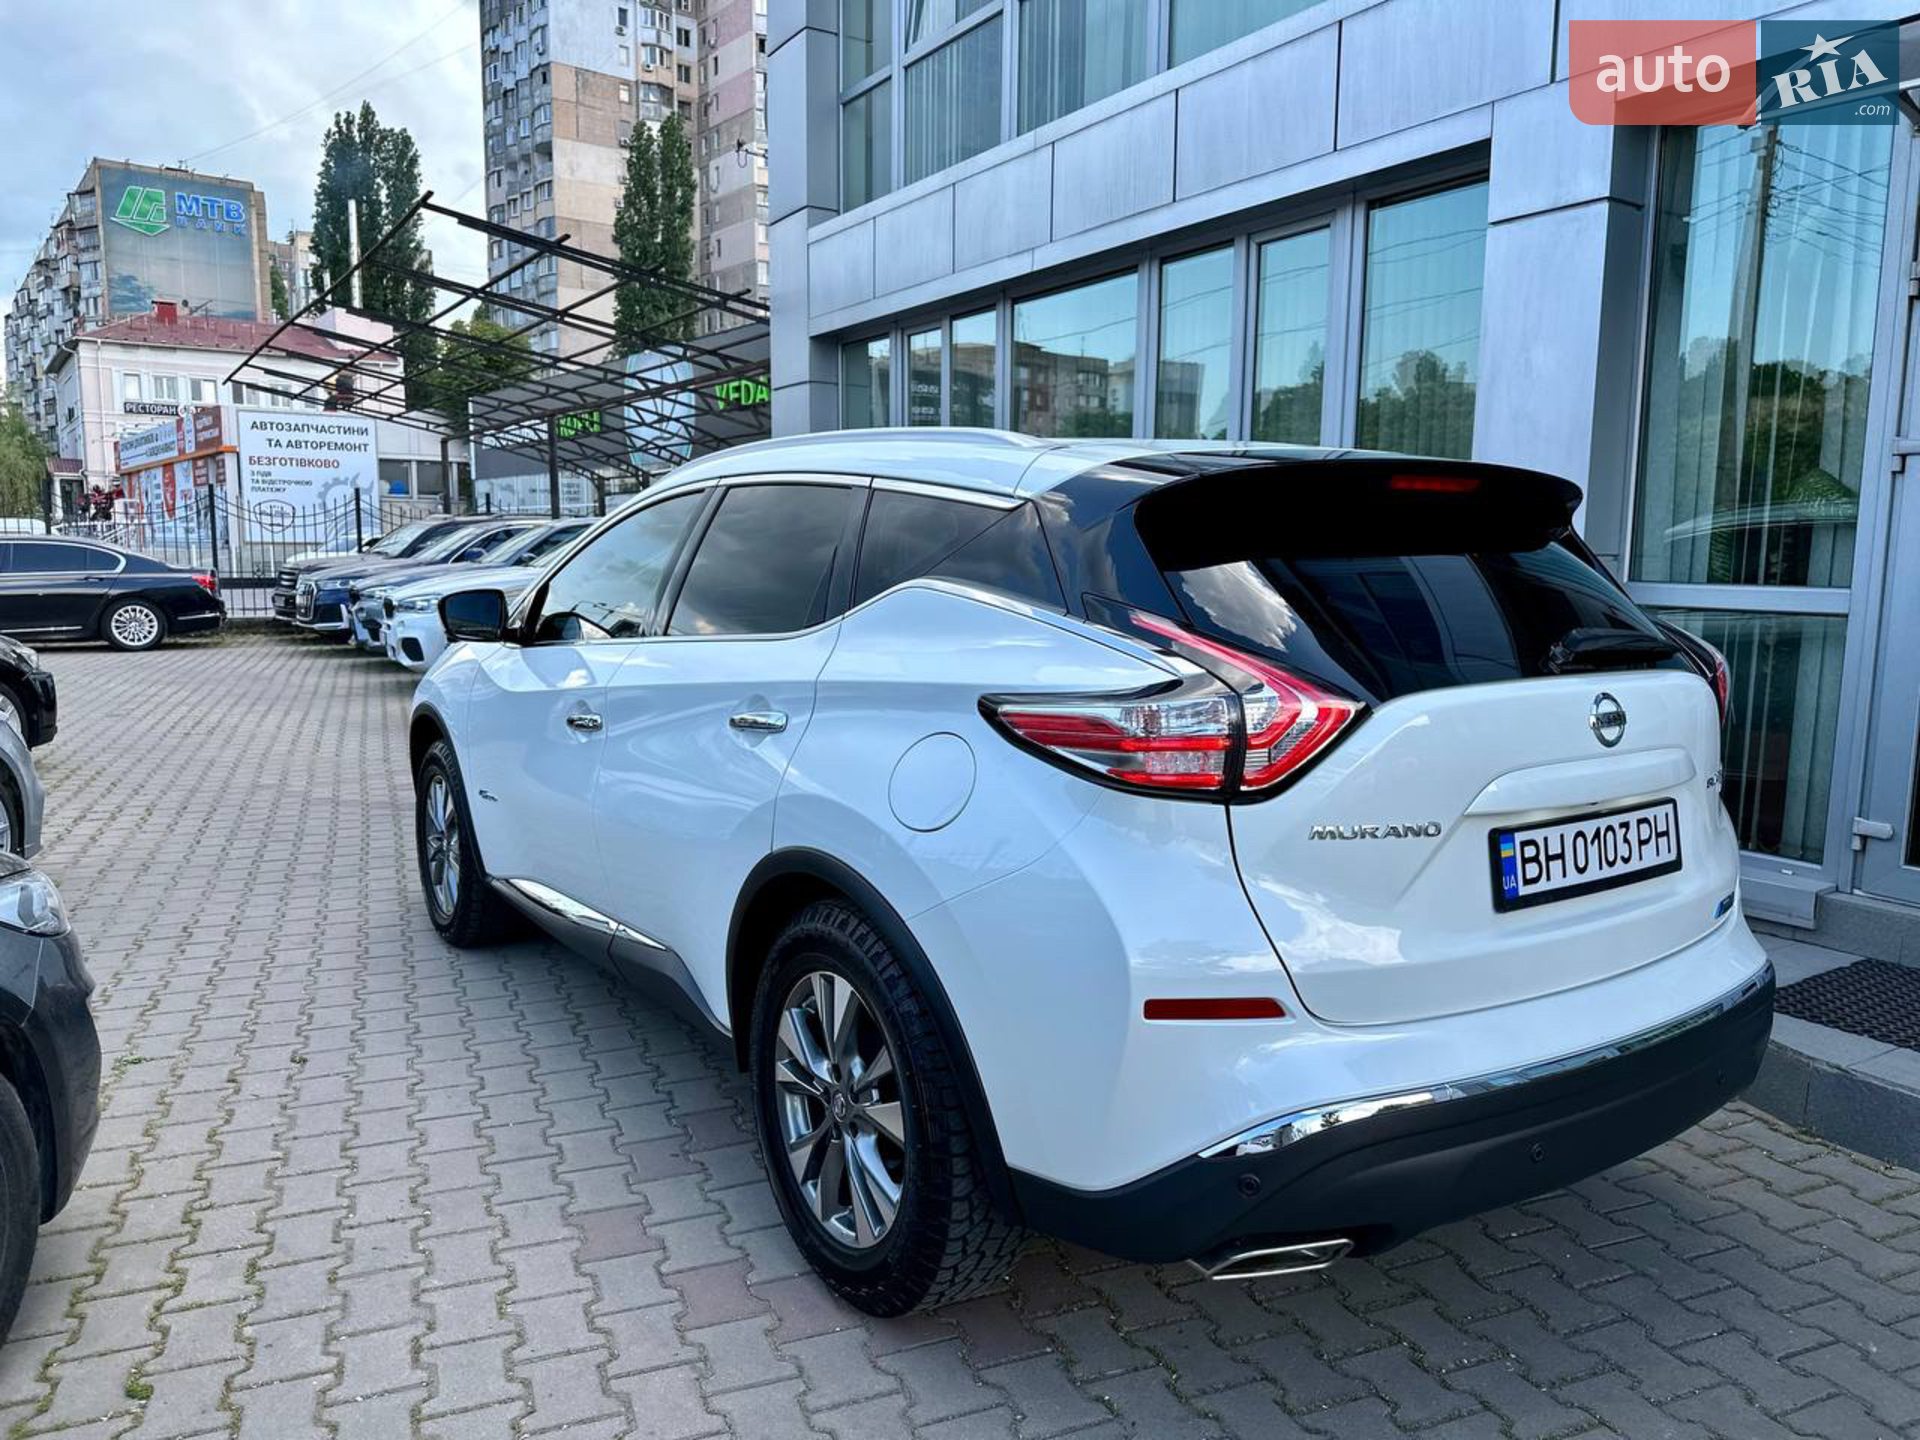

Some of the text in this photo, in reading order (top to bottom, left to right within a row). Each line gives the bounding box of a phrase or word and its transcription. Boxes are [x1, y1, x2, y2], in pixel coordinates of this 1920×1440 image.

[175, 191, 246, 223] MTB
[125, 403, 177, 415] РЕСТОРАН
[250, 420, 369, 437] АВТОЗАПЧАСТИНИ
[266, 438, 370, 453] ТА АВТОРЕМОНТ
[248, 456, 340, 469] БЕЗГОТІВКОВО
[1308, 821, 1442, 841] MURANO
[1519, 812, 1672, 887] BH 0103 PH
[1502, 874, 1518, 890] UA
